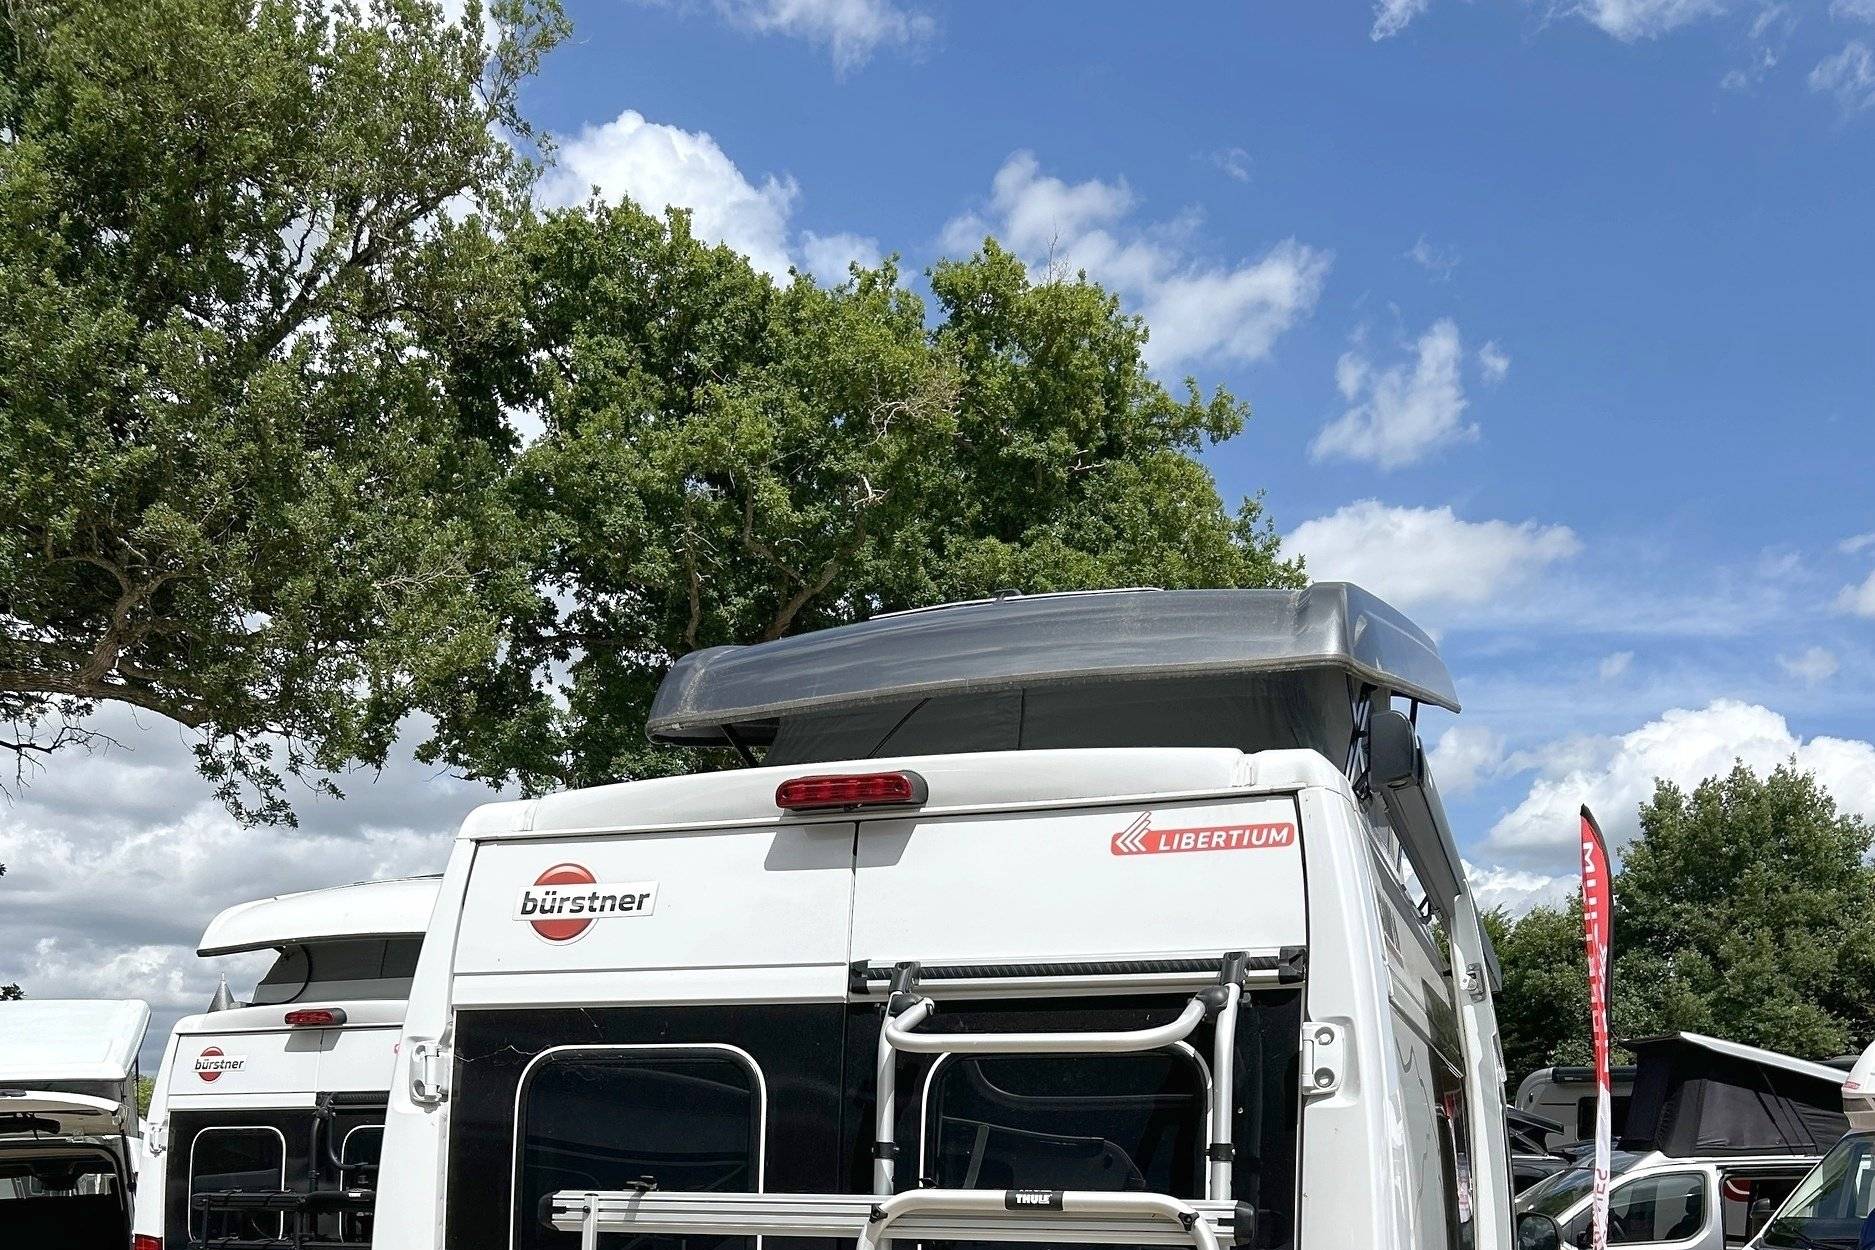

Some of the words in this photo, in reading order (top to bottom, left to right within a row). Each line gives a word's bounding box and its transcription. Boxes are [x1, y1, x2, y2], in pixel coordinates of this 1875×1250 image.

[1158, 827, 1289, 850] LIBERTIUM
[520, 890, 650, 915] bürstner
[195, 1058, 244, 1070] bürstner
[1016, 1193, 1052, 1204] THULE
